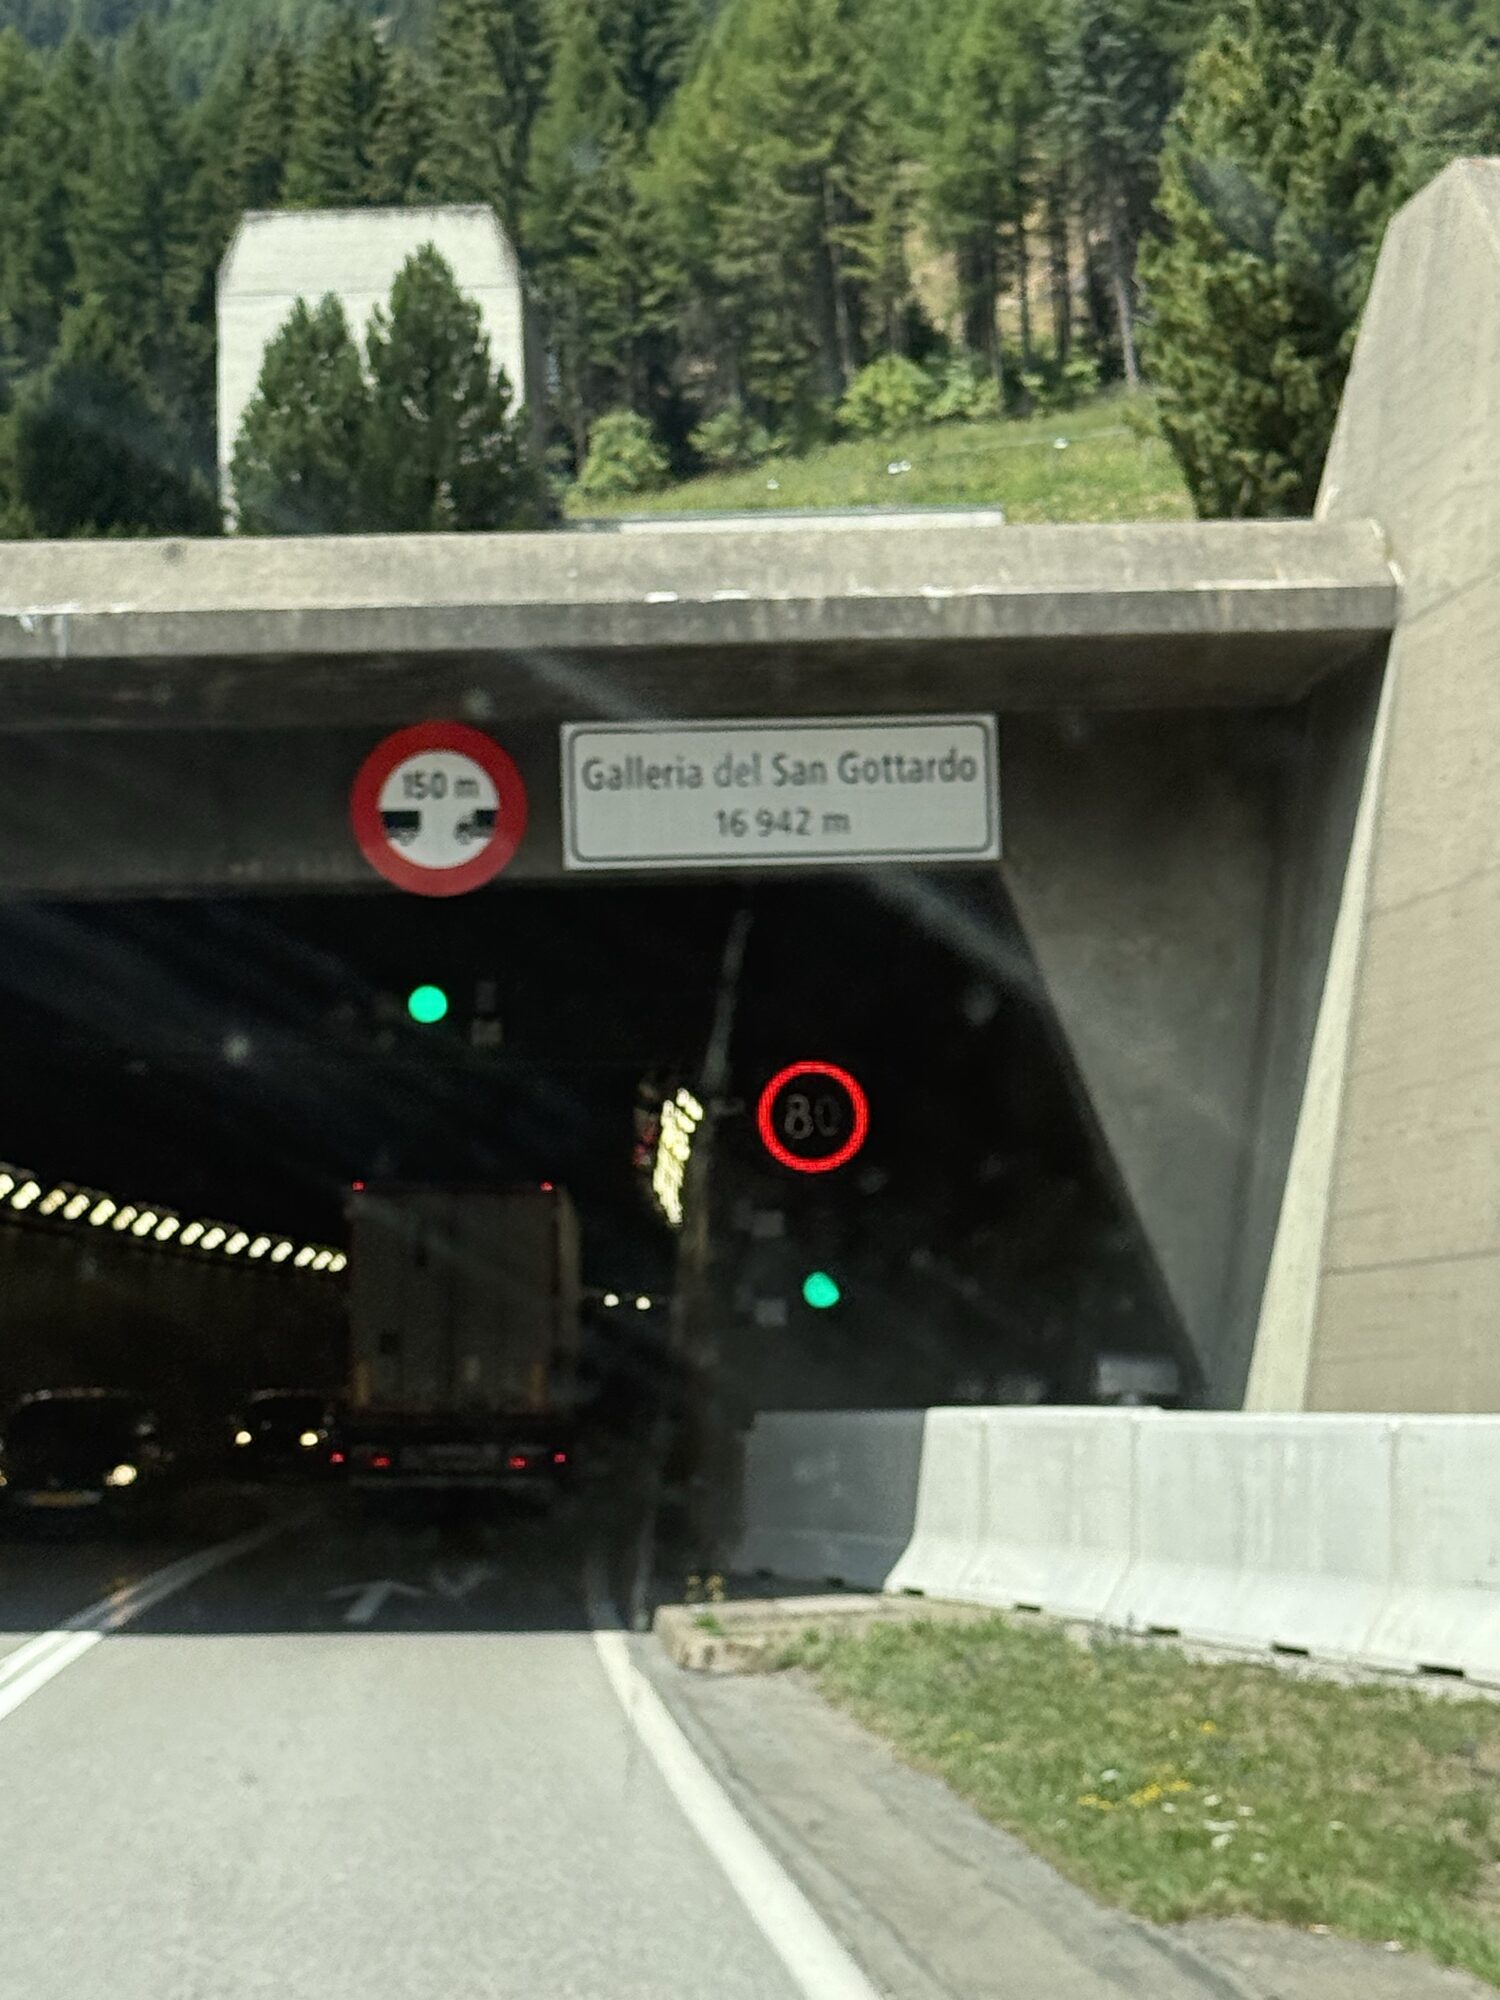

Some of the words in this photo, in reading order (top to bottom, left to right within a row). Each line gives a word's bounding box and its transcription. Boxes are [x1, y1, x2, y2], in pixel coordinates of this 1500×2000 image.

[403, 771, 448, 800] 150
[454, 779, 480, 798] m
[582, 753, 704, 791] Galleria
[714, 752, 761, 787] del
[772, 752, 829, 786] San
[837, 746, 977, 784] Gottardo
[821, 813, 851, 834] m
[784, 1093, 842, 1139] 80
